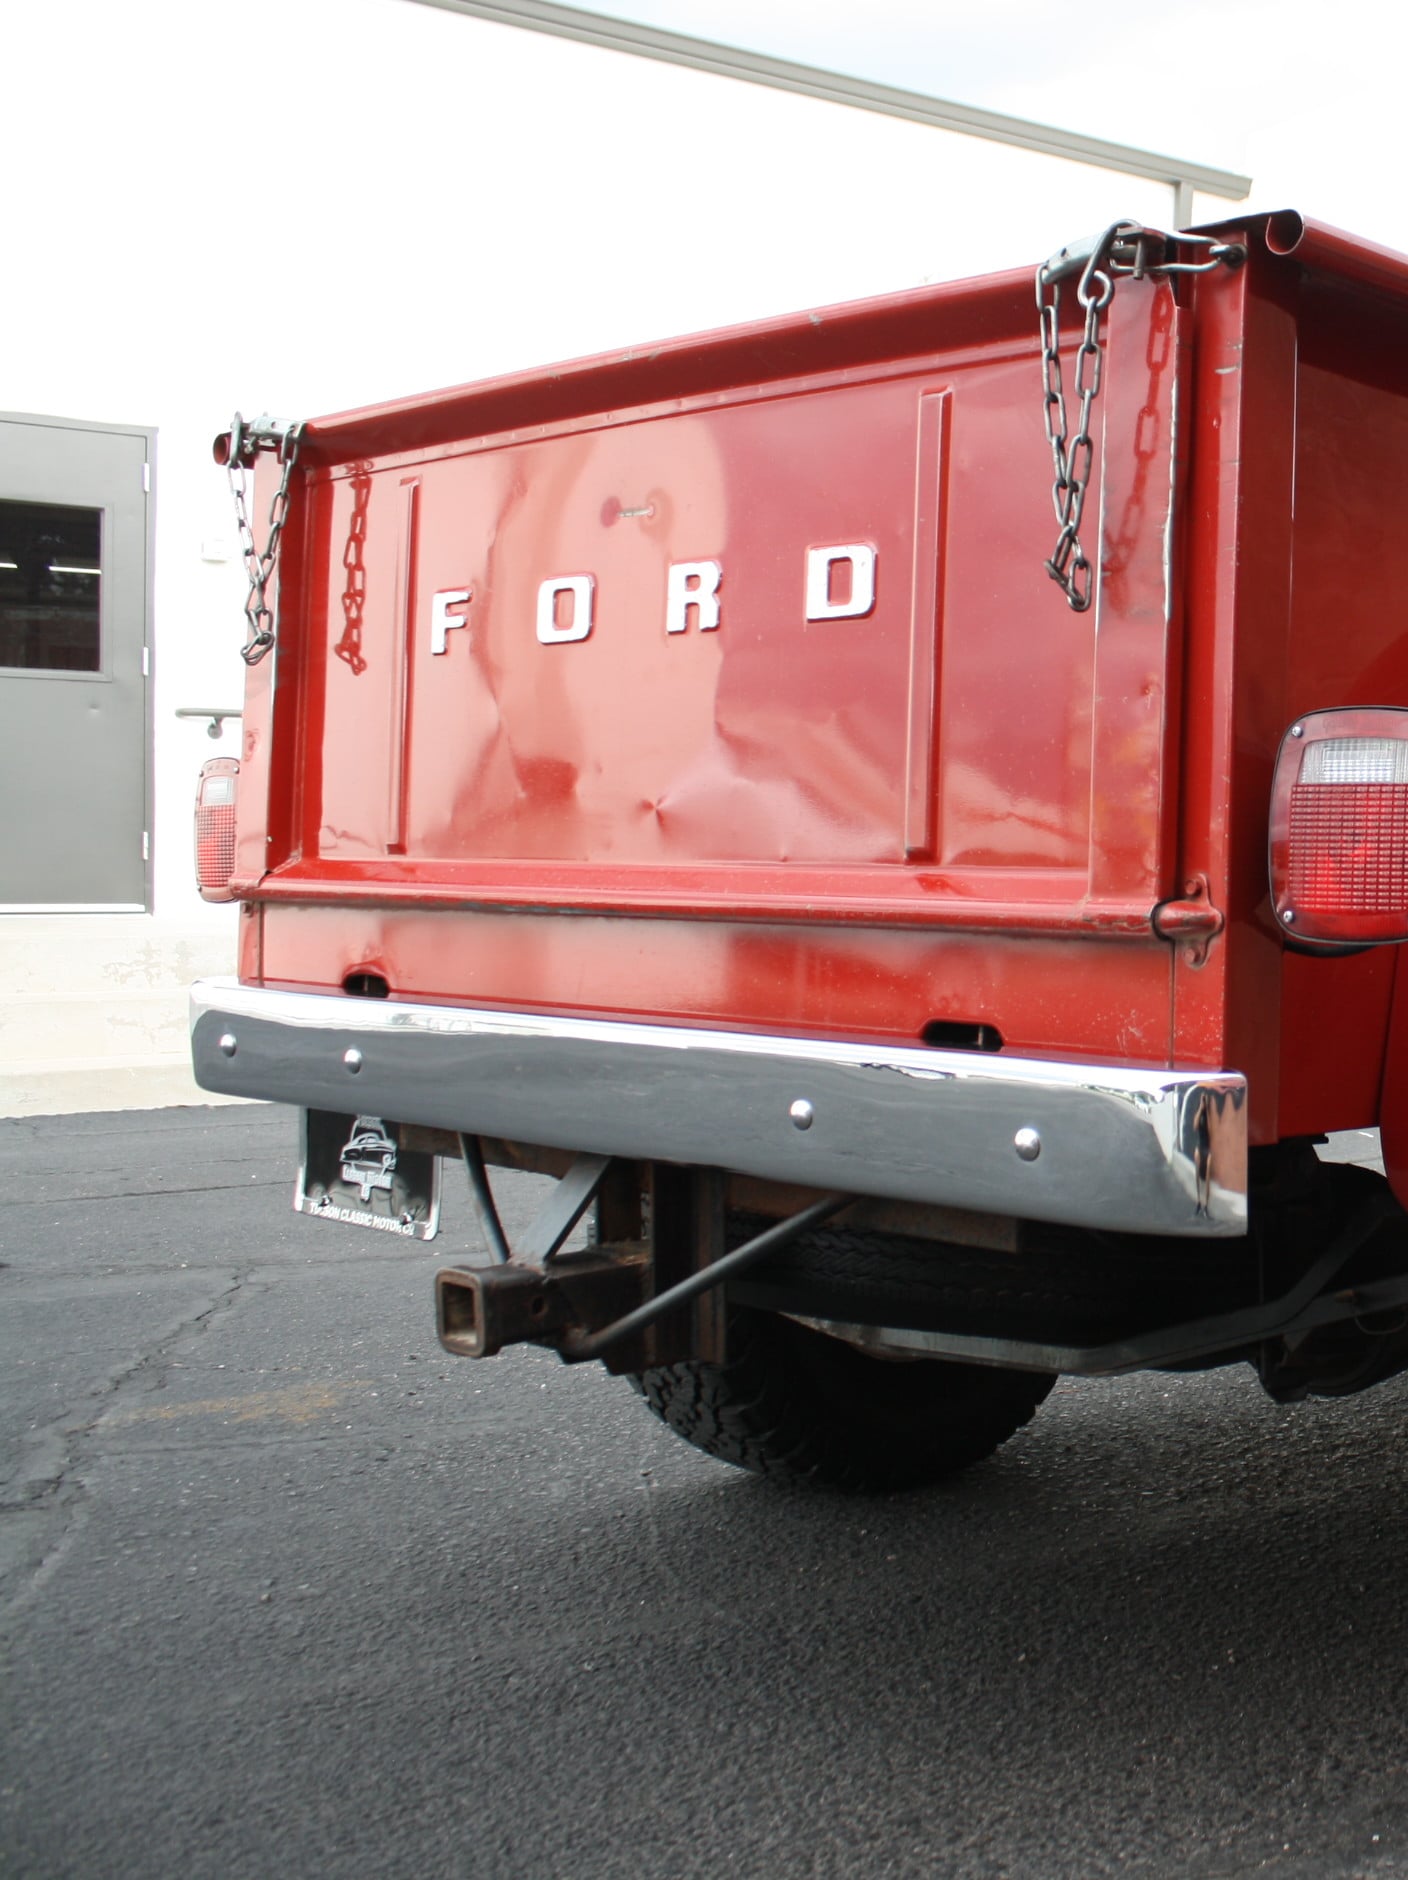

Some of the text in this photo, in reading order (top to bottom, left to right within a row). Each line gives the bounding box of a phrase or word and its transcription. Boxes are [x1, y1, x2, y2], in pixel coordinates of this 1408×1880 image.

[431, 541, 878, 655] FORD
[310, 1202, 342, 1219] TUSON
[341, 1209, 373, 1227] CLASSIC
